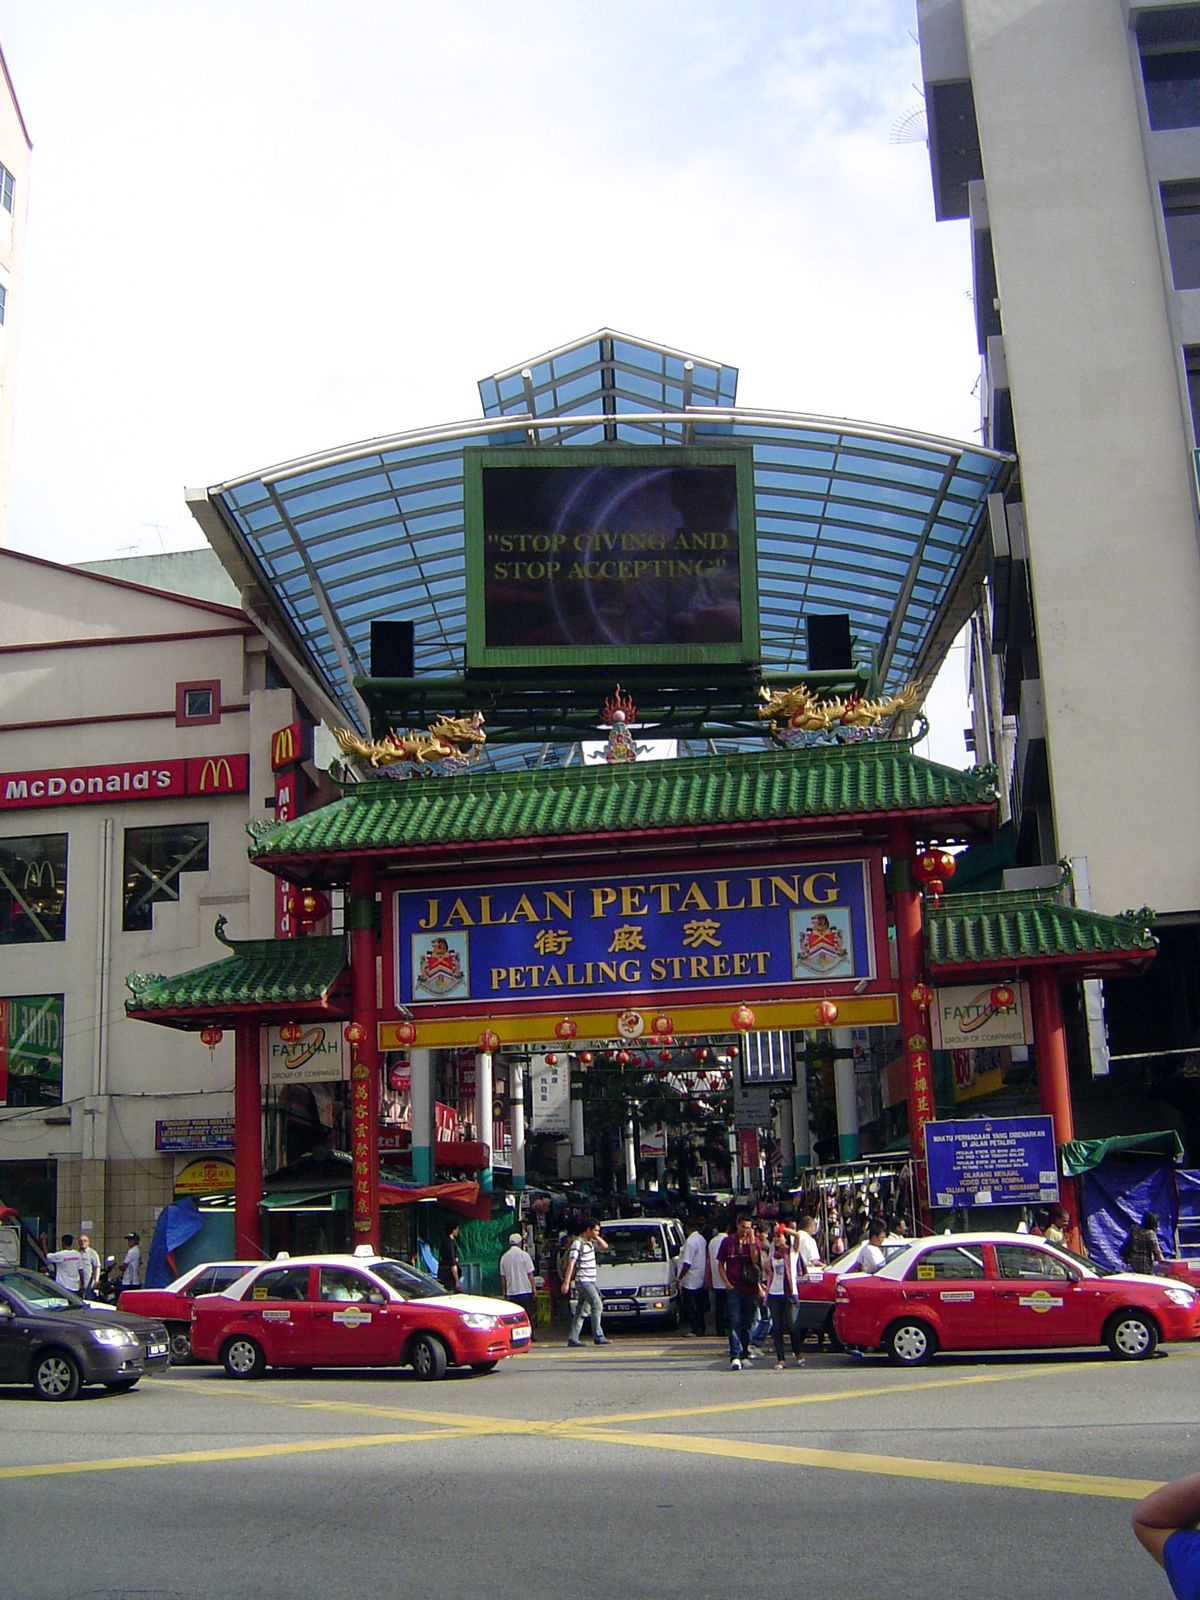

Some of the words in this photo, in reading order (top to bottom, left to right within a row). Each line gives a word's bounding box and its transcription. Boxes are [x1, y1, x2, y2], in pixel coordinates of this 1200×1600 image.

[488, 534, 567, 552] "STOP
[573, 532, 666, 552] GIVING
[674, 532, 729, 550] AND
[494, 561, 560, 580] STOP
[568, 560, 727, 579] ACCEPTING"
[5, 769, 171, 799] McDonald's
[418, 890, 575, 929] JALAN
[590, 872, 840, 918] PETALING
[490, 960, 641, 990] PETALING
[651, 952, 771, 981] STREET
[945, 1036, 969, 1044] GROUP
